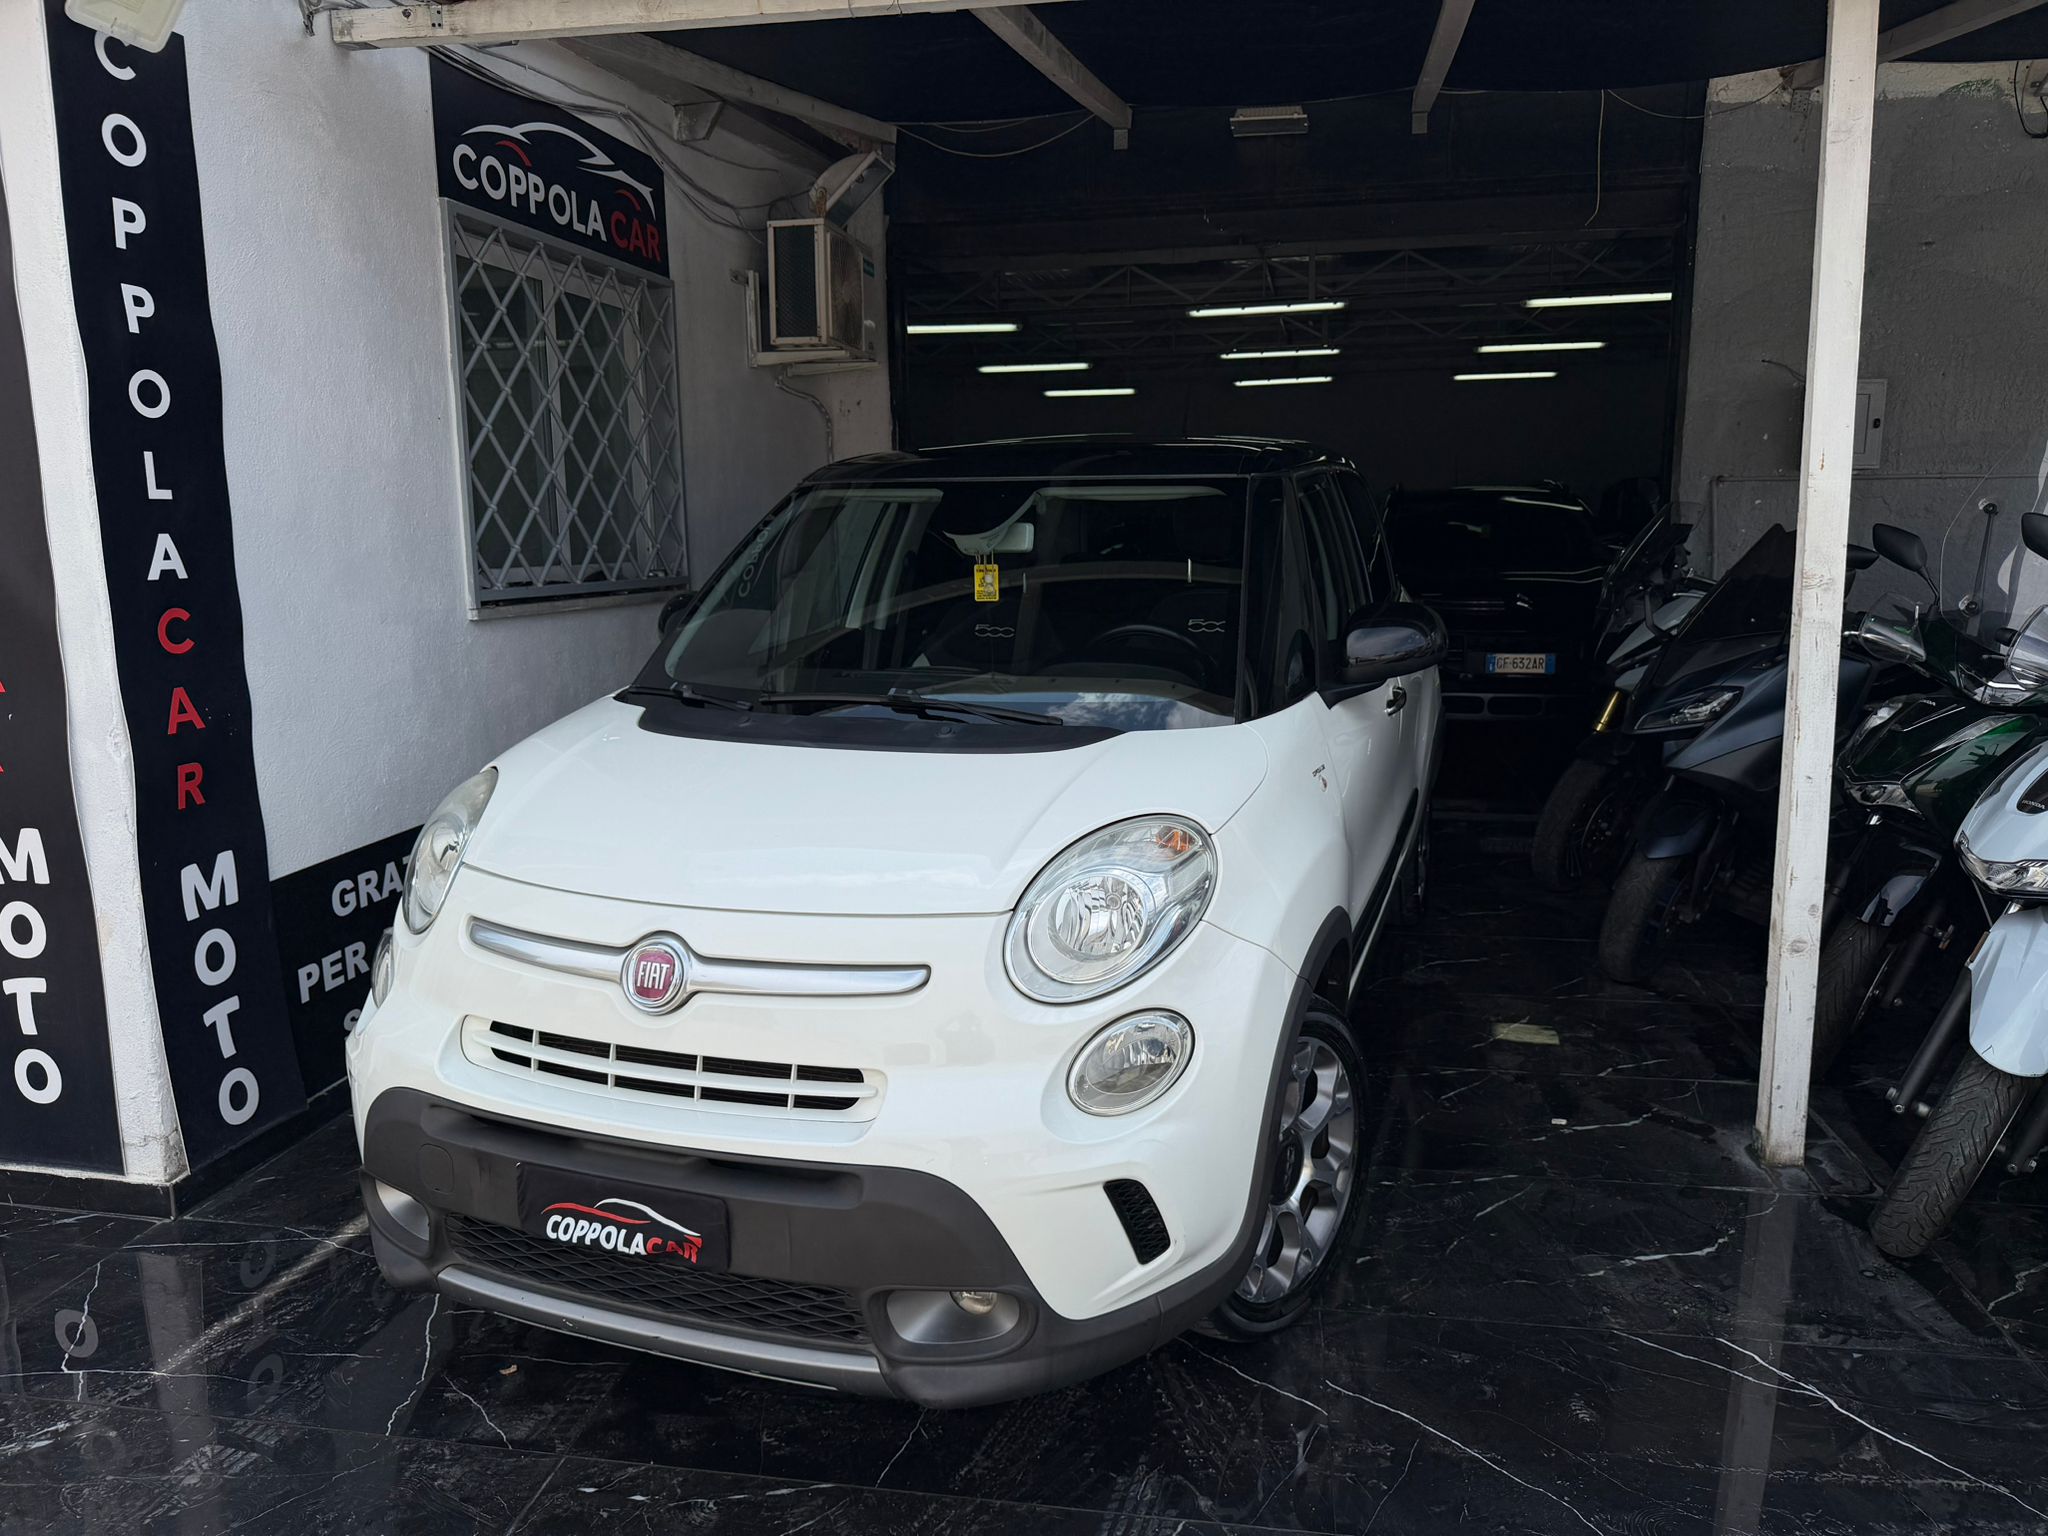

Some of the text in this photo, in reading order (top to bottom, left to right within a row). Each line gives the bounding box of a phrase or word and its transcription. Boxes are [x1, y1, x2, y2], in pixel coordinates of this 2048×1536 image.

[94, 31, 261, 1126] COPPOLA CAR MOTO
[331, 855, 411, 918] GRA
[0, 827, 63, 1105] MOTO
[297, 940, 370, 1005] PER
[636, 960, 671, 990] FIAT
